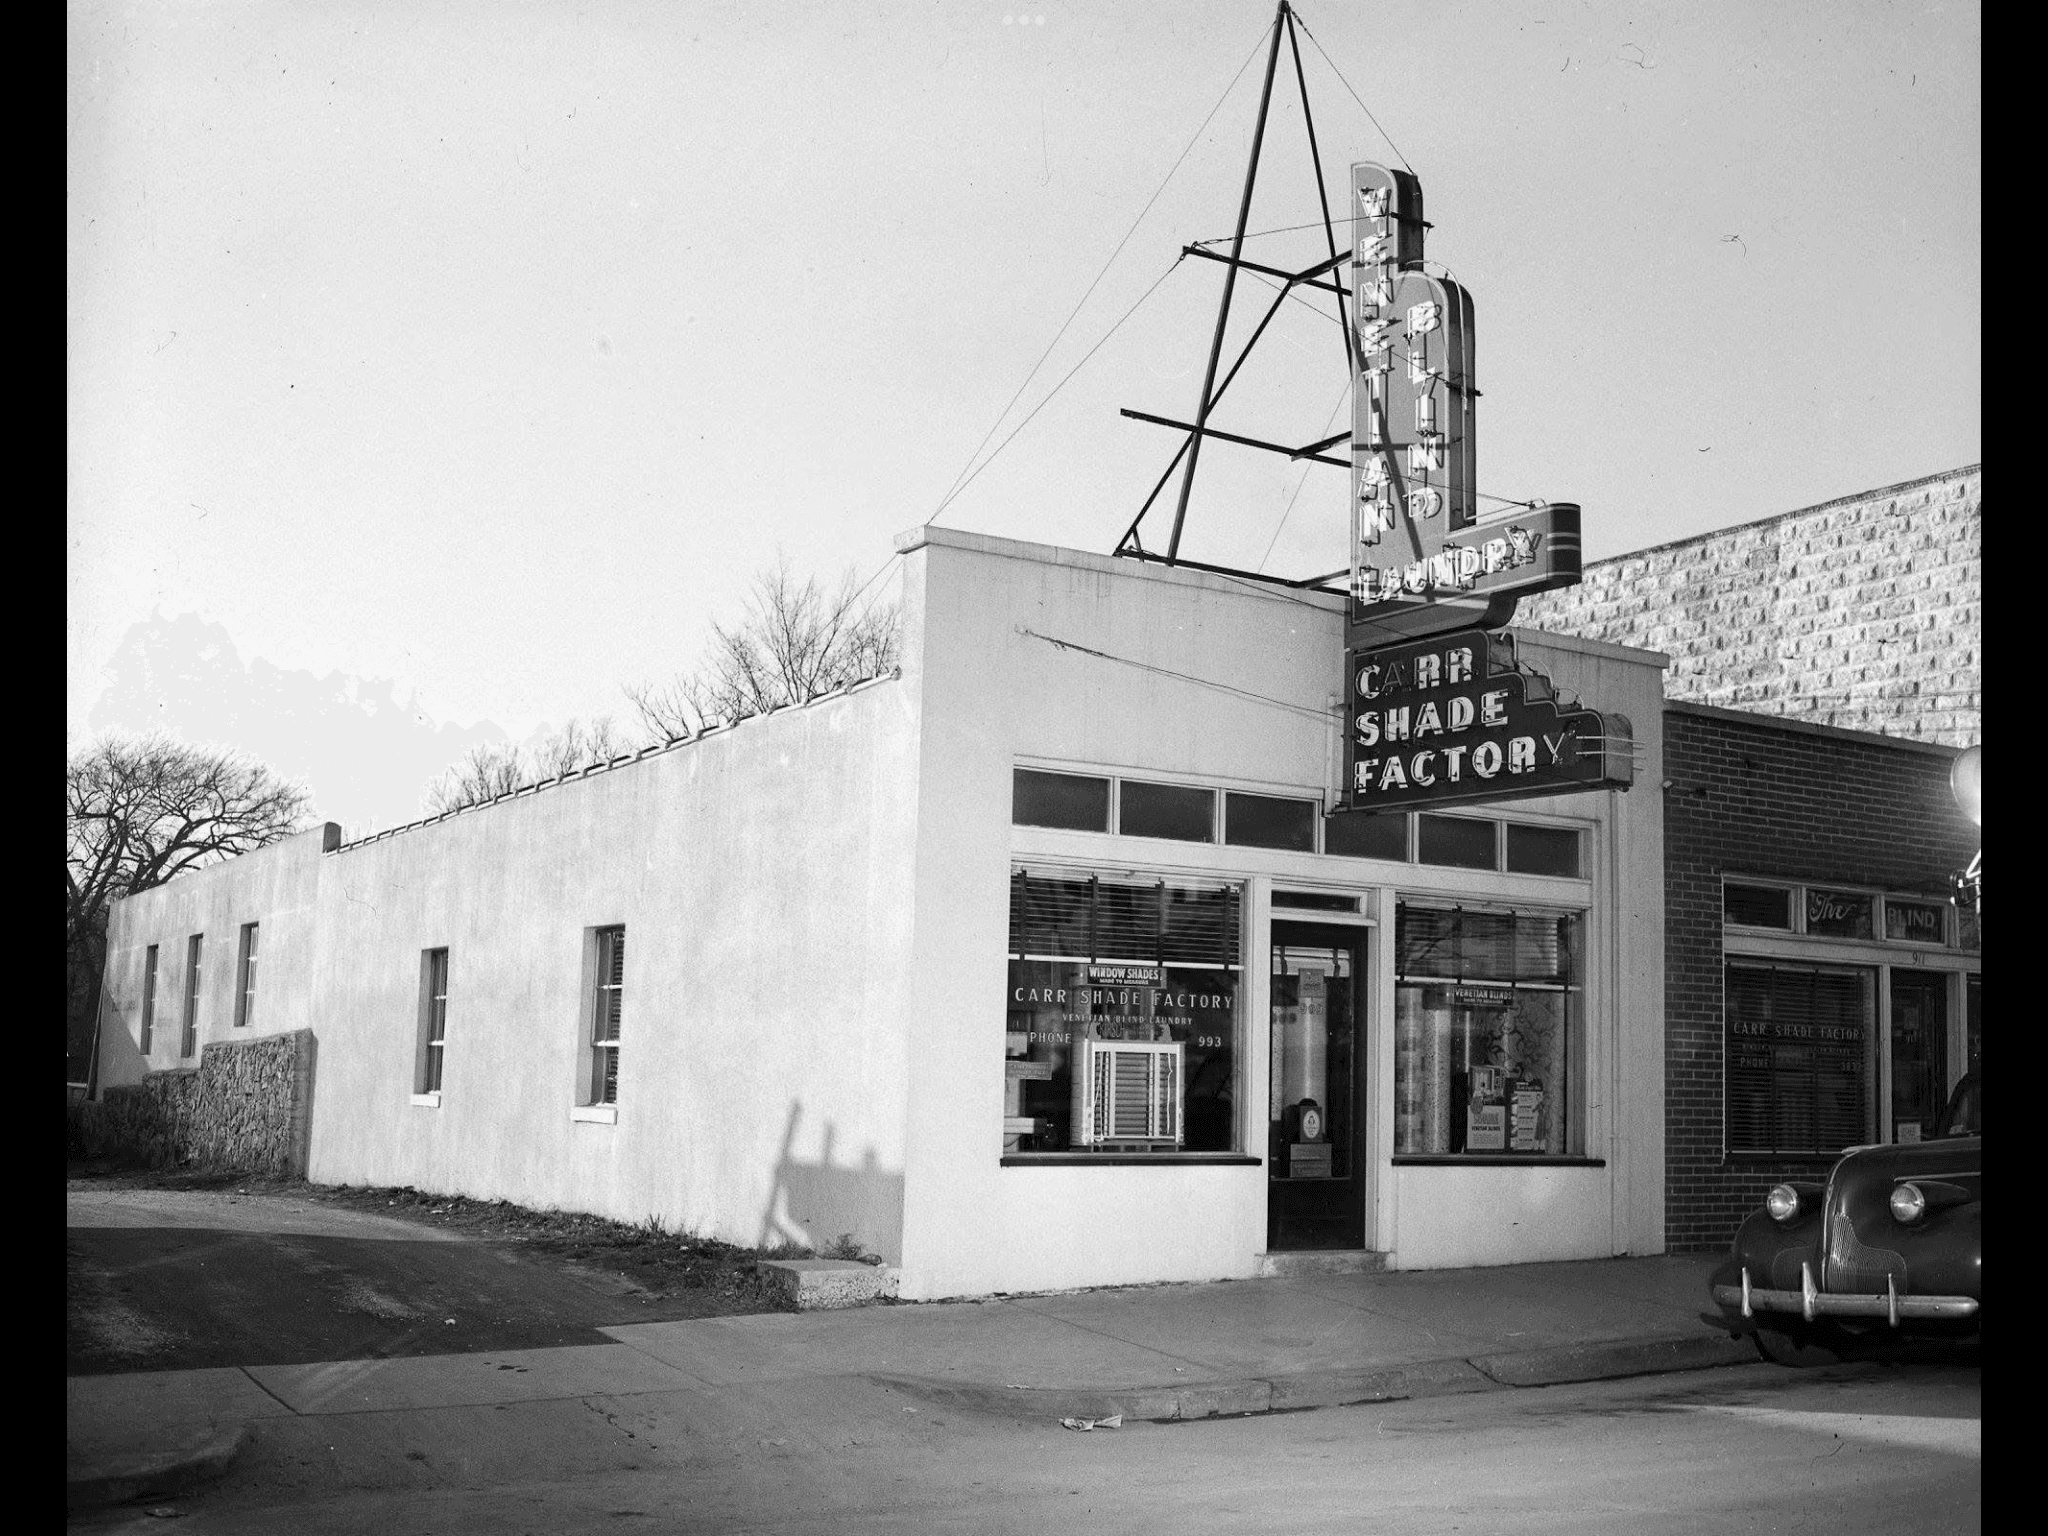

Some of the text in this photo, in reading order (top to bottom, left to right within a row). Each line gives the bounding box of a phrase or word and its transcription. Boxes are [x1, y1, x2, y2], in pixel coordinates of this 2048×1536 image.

[1358, 186, 1395, 546] VENETIAN
[1404, 300, 1443, 519] BLIND
[1358, 525, 1540, 605] LAUNDRY
[1355, 647, 1474, 699] CARR
[1355, 690, 1509, 746] SHADE
[1354, 732, 1570, 794] FACTORY
[1808, 893, 1857, 922] The
[1088, 966, 1159, 980] WINDOW SHADES
[1015, 987, 1233, 1009] CARR SHADE FACTORY
[1030, 1031, 1222, 1048] PHONE 993
[1062, 1013, 1193, 1026] VENETIAN BLIND LAUNDRY
[1733, 1021, 1866, 1041] CARR SHADE FACTORY
